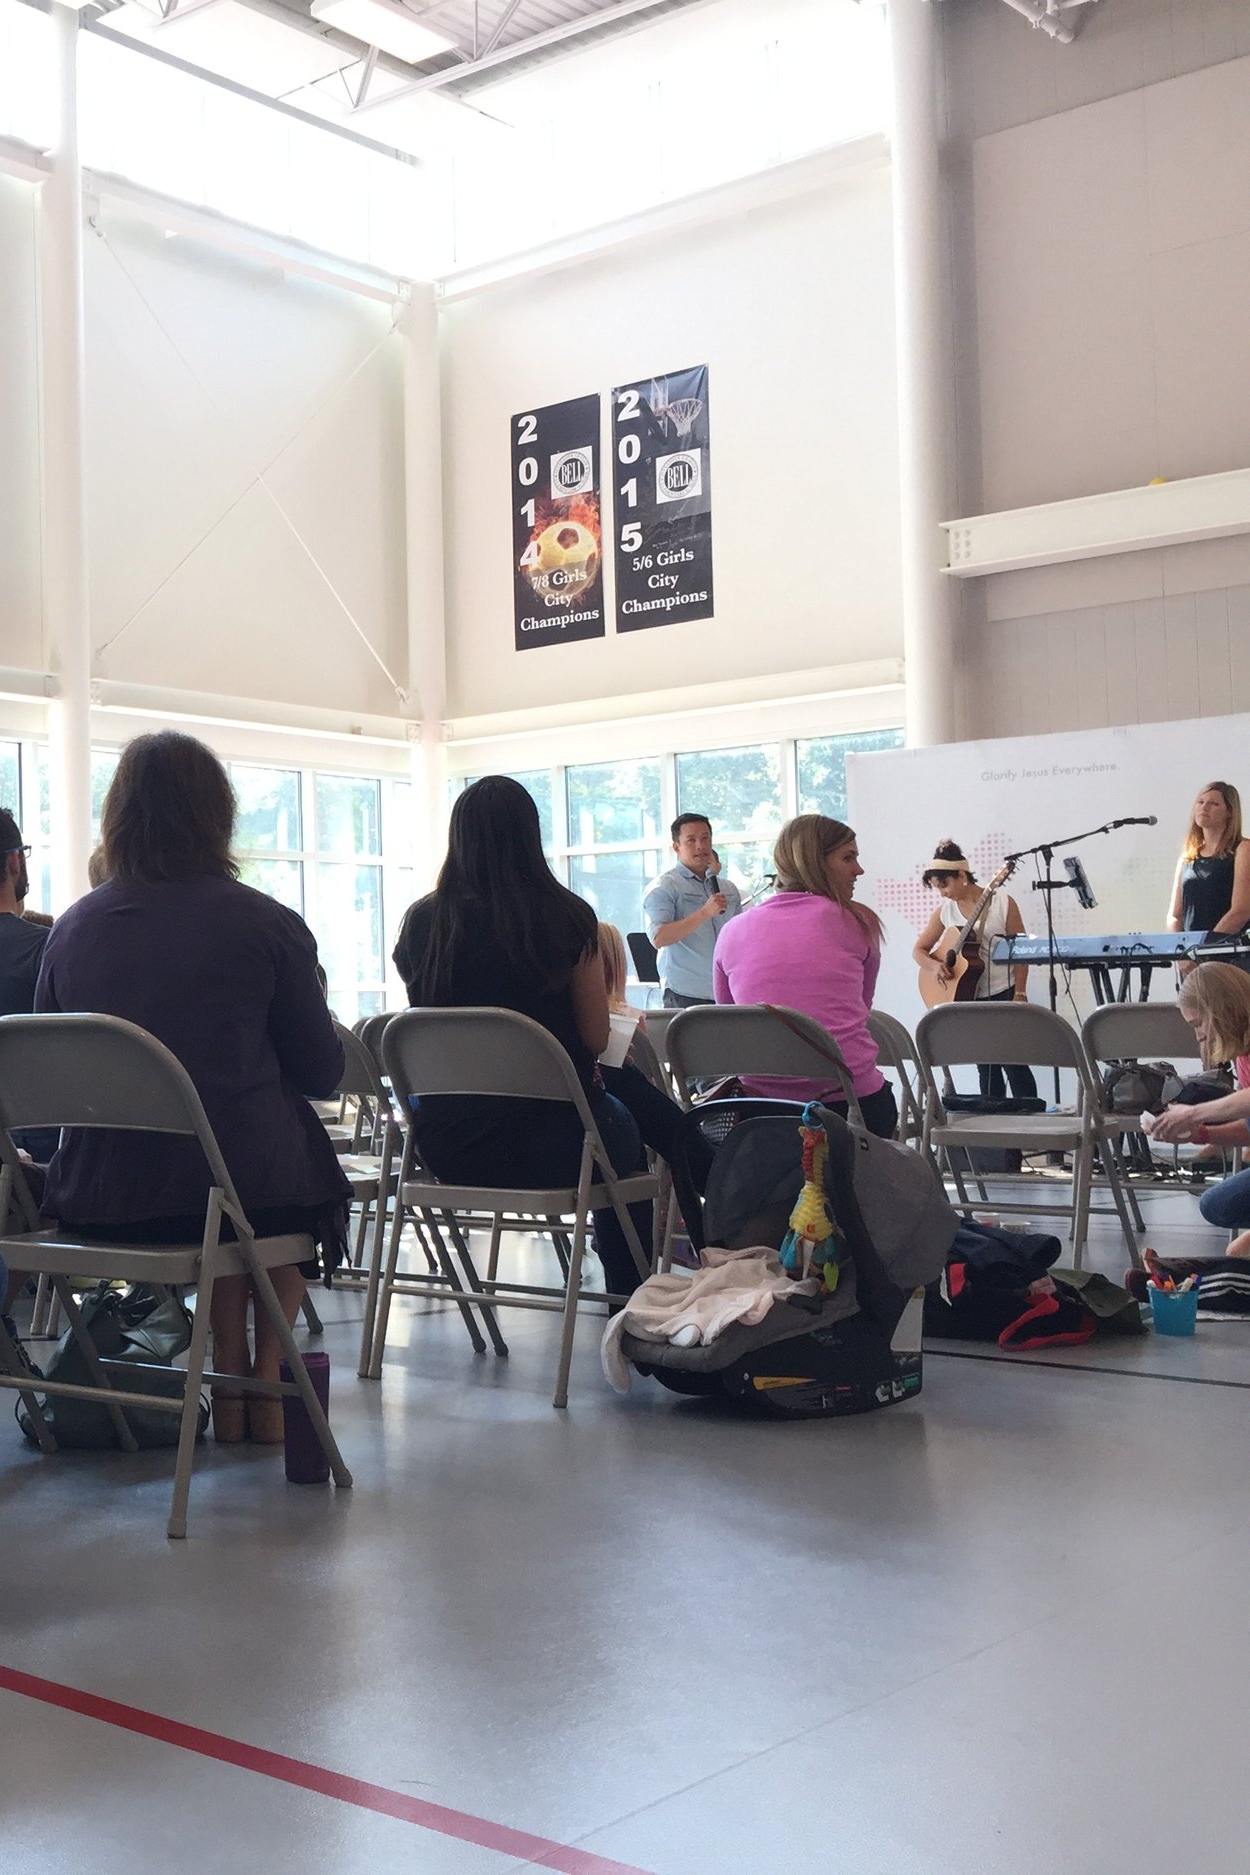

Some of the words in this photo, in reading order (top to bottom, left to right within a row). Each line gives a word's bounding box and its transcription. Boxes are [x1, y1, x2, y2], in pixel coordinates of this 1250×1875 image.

[561, 460, 583, 485] BELL
[667, 463, 692, 489] BELL
[632, 554, 653, 571] 5/6
[656, 548, 694, 566] Girls
[531, 574, 549, 590] 7/8
[552, 568, 587, 585] Girls
[647, 573, 679, 589] City
[544, 592, 573, 607] City
[621, 590, 708, 614] Champions
[520, 609, 599, 631] Champions
[980, 768, 1017, 782] Glorify
[1021, 768, 1048, 779] Jesus
